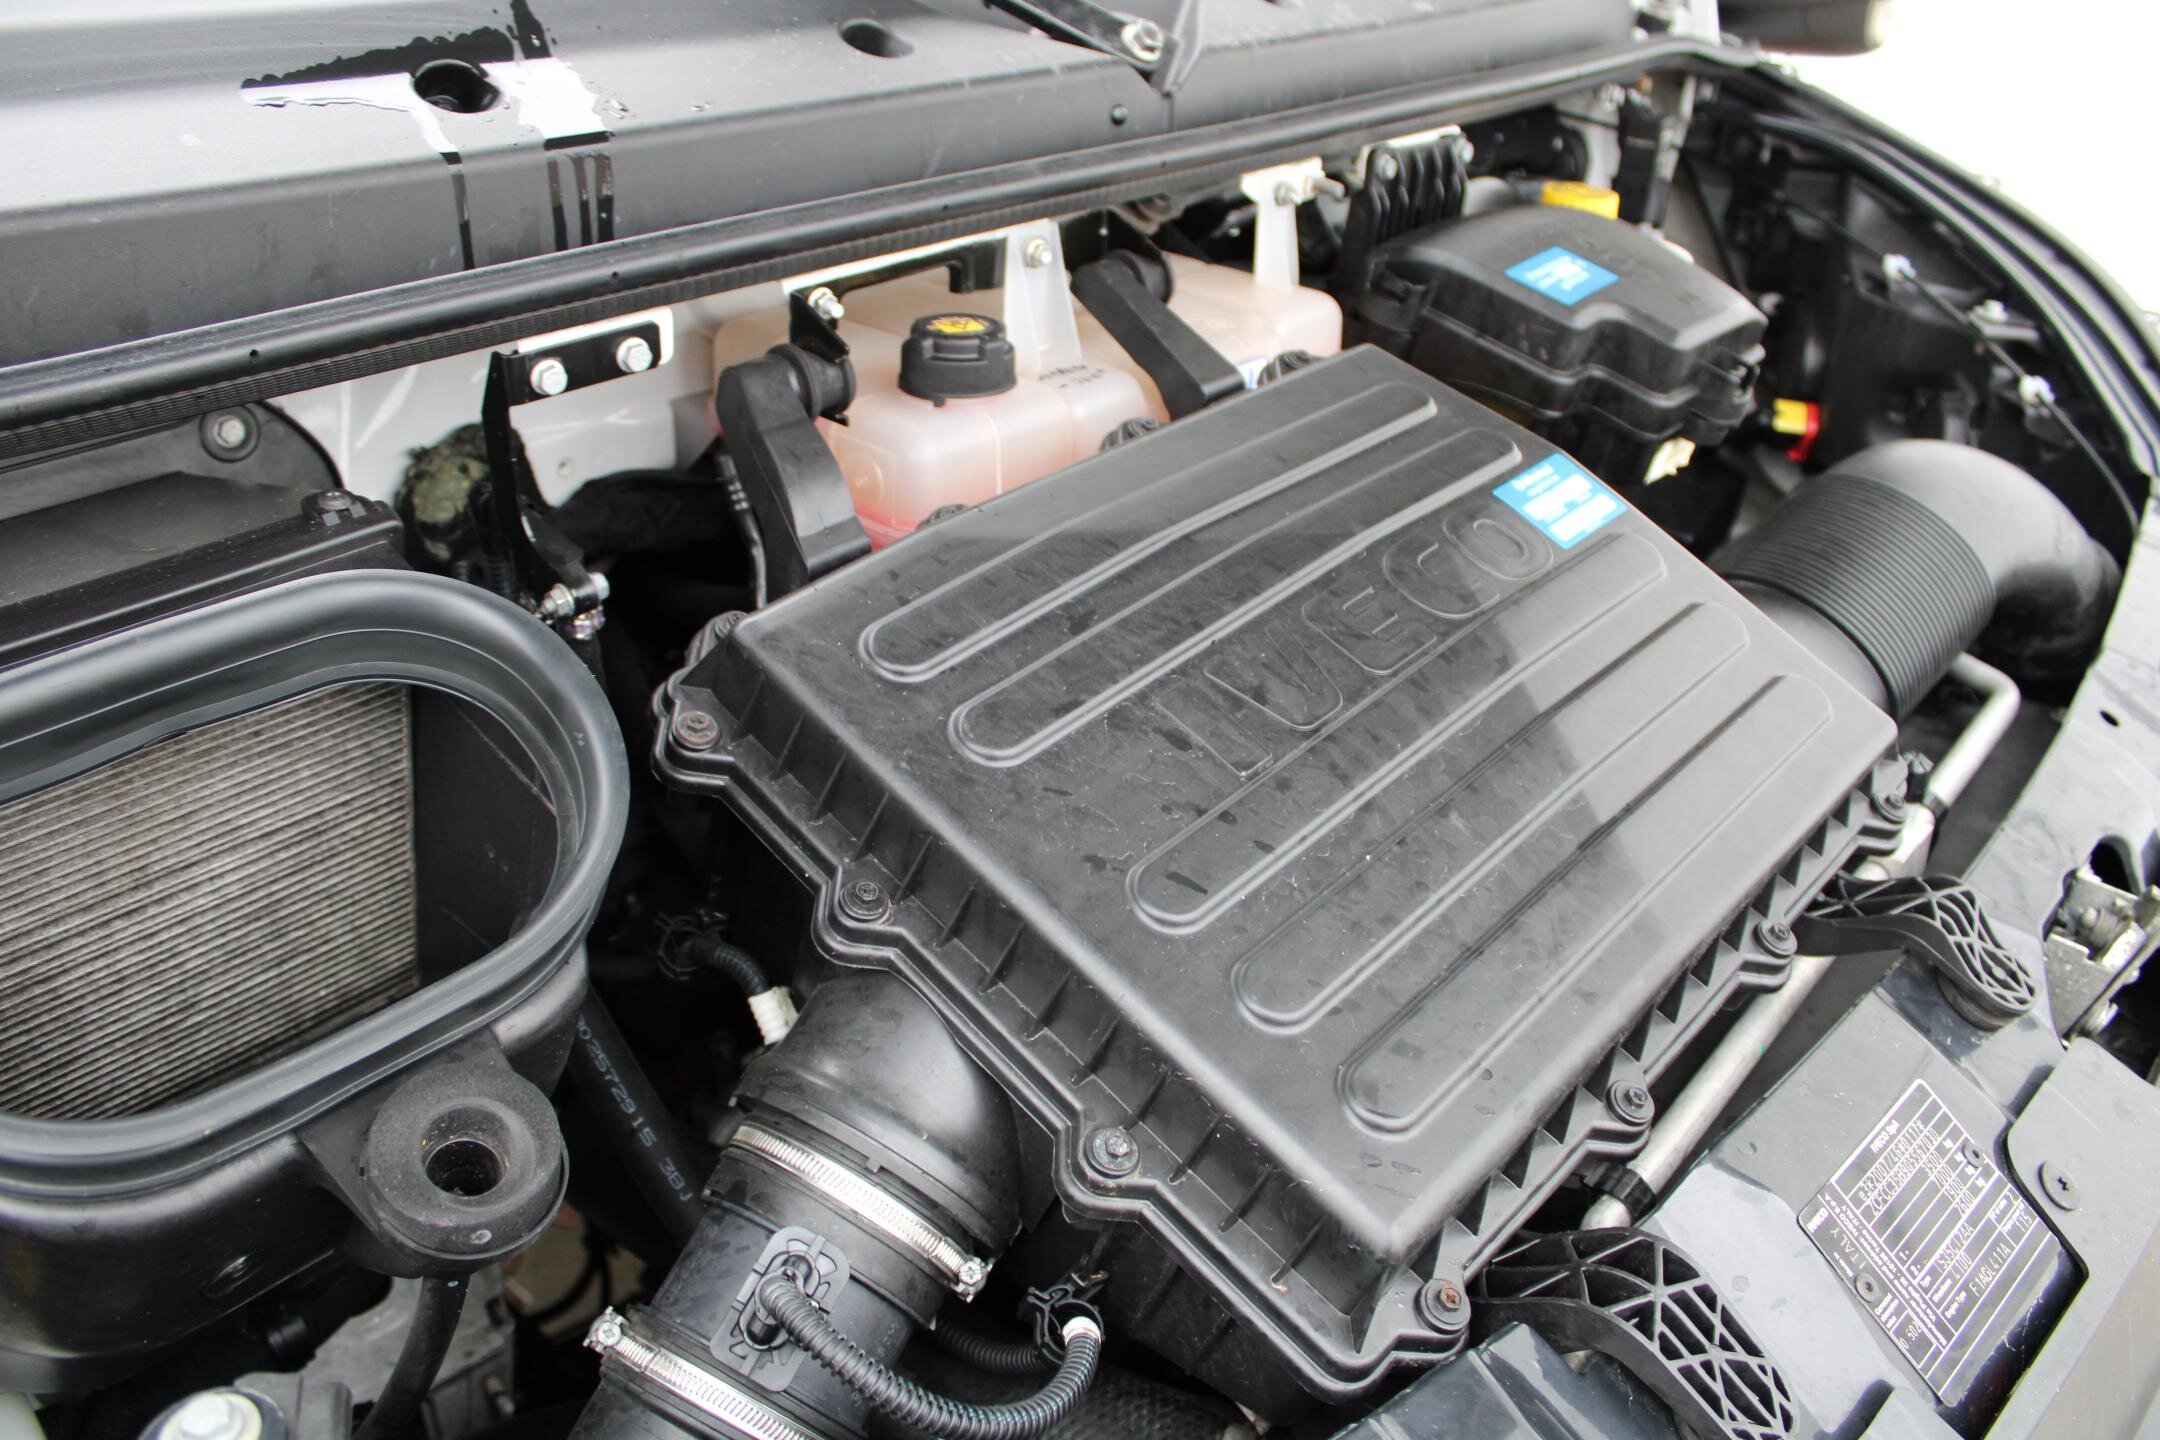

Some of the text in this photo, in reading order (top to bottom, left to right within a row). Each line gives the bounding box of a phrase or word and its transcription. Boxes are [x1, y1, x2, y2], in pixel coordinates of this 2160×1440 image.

[1153, 509, 1553, 777] IVECO
[1868, 1129, 1891, 1155] IVECO
[1920, 1150, 1943, 1176] 3500
[1931, 1162, 1954, 1190] 7000
[1943, 1175, 1965, 1202] 1900
[1953, 1189, 1976, 1216] 2600
[2014, 1209, 2033, 1233] 115
[1829, 1223, 1866, 1270] ITALY
[1948, 1249, 1973, 1281] 4100
